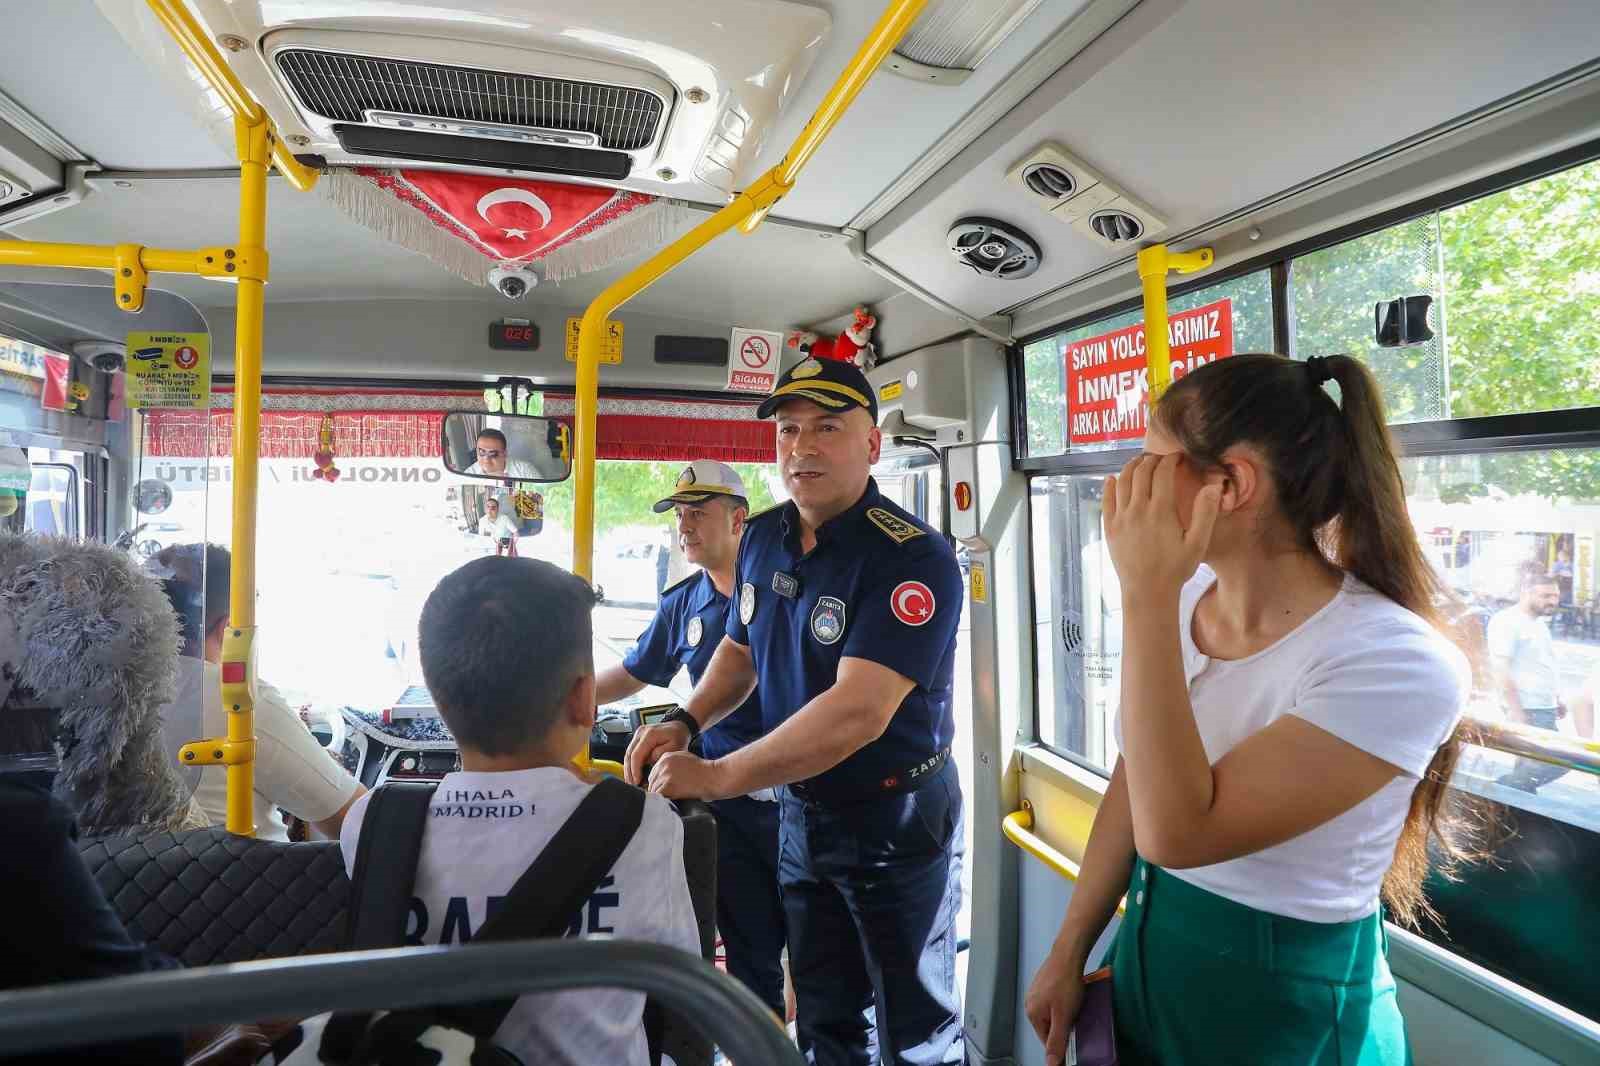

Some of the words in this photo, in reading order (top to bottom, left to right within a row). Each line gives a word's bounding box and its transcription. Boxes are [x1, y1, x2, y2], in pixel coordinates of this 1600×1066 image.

[1072, 340, 1107, 371] SAYIN
[1078, 367, 1149, 405] İNMEK
[1073, 411, 1100, 435] ARKA
[1102, 408, 1140, 433] KAPIYI
